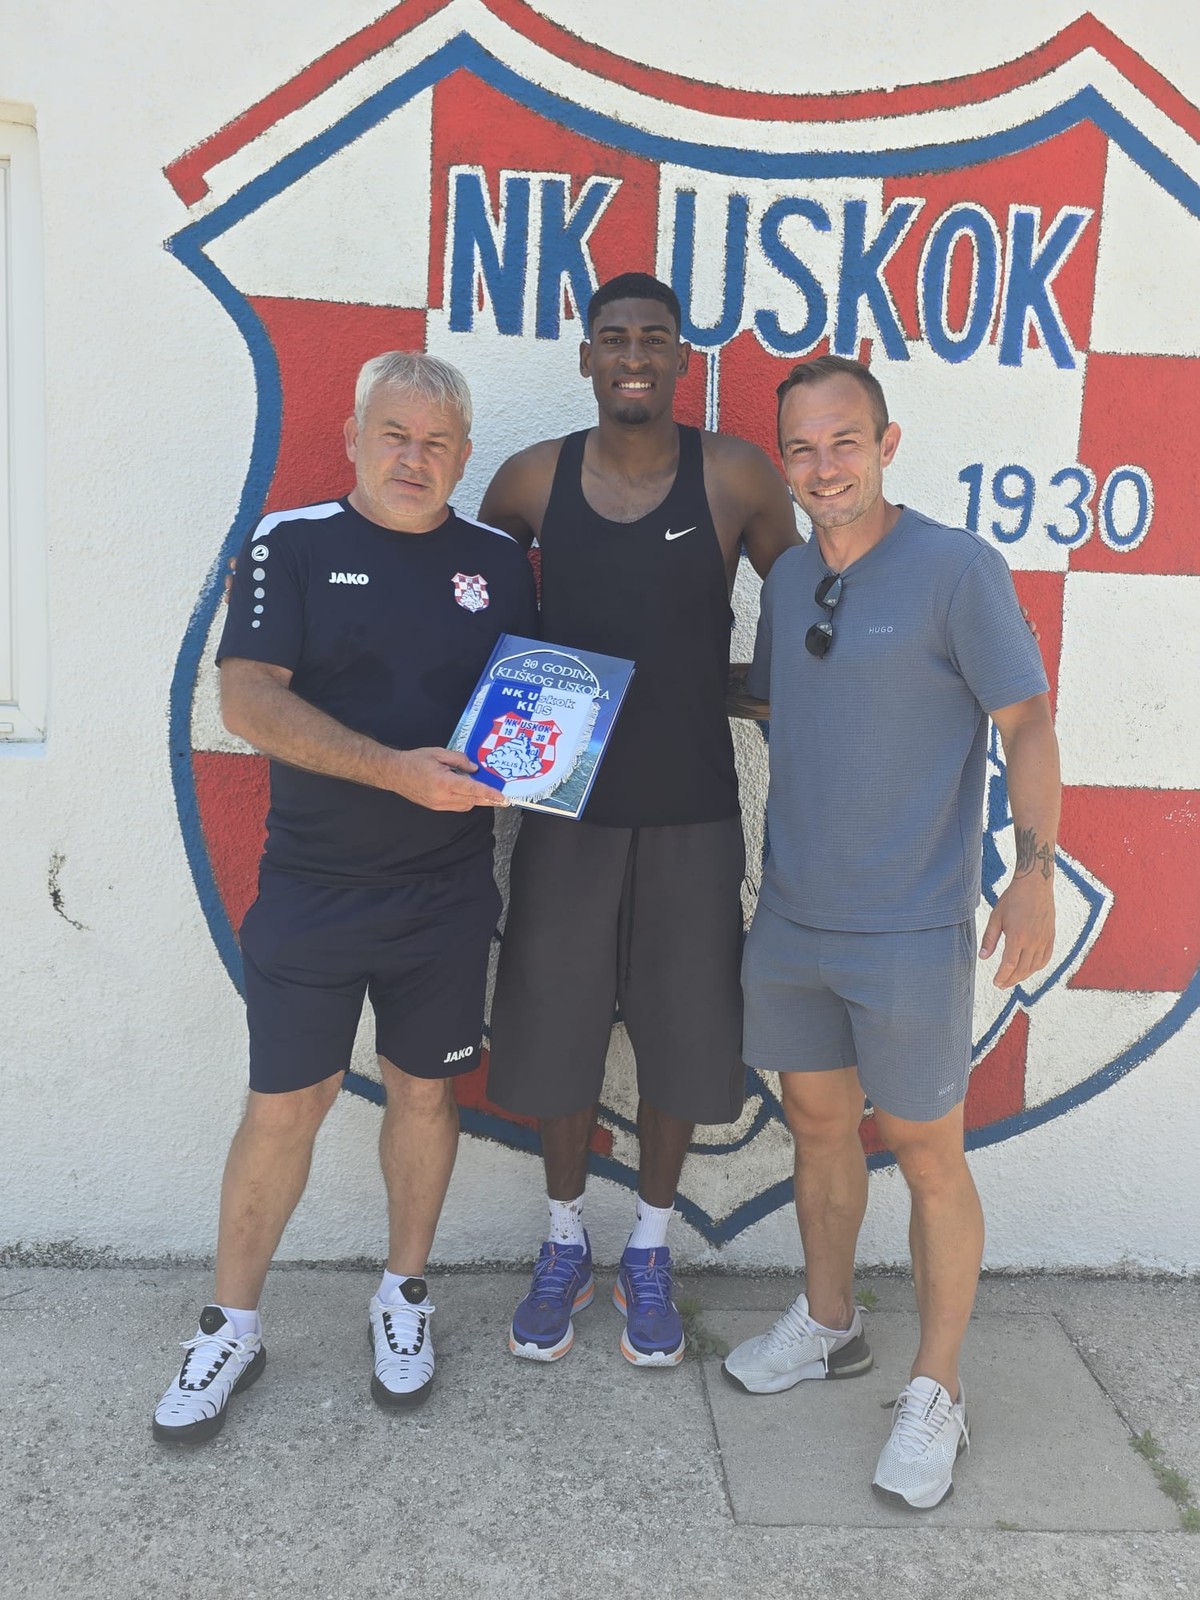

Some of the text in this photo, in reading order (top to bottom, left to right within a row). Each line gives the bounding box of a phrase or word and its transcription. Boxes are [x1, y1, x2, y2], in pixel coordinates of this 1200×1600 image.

[448, 170, 1093, 370] NK USKOK
[958, 462, 1153, 549] 1930
[329, 572, 369, 585] JAKO
[869, 626, 894, 635] HUGO
[523, 658, 594, 682] 80 GODINA
[496, 666, 610, 700] KLIŠKOG USKOKA
[502, 687, 524, 698] NK
[516, 700, 552, 715] KLIS
[504, 719, 551, 733] NK USKOK
[504, 728, 546, 742] 19 30
[501, 760, 519, 768] KLIS
[443, 1046, 474, 1063] JAKO
[938, 1083, 954, 1096] HUGO
